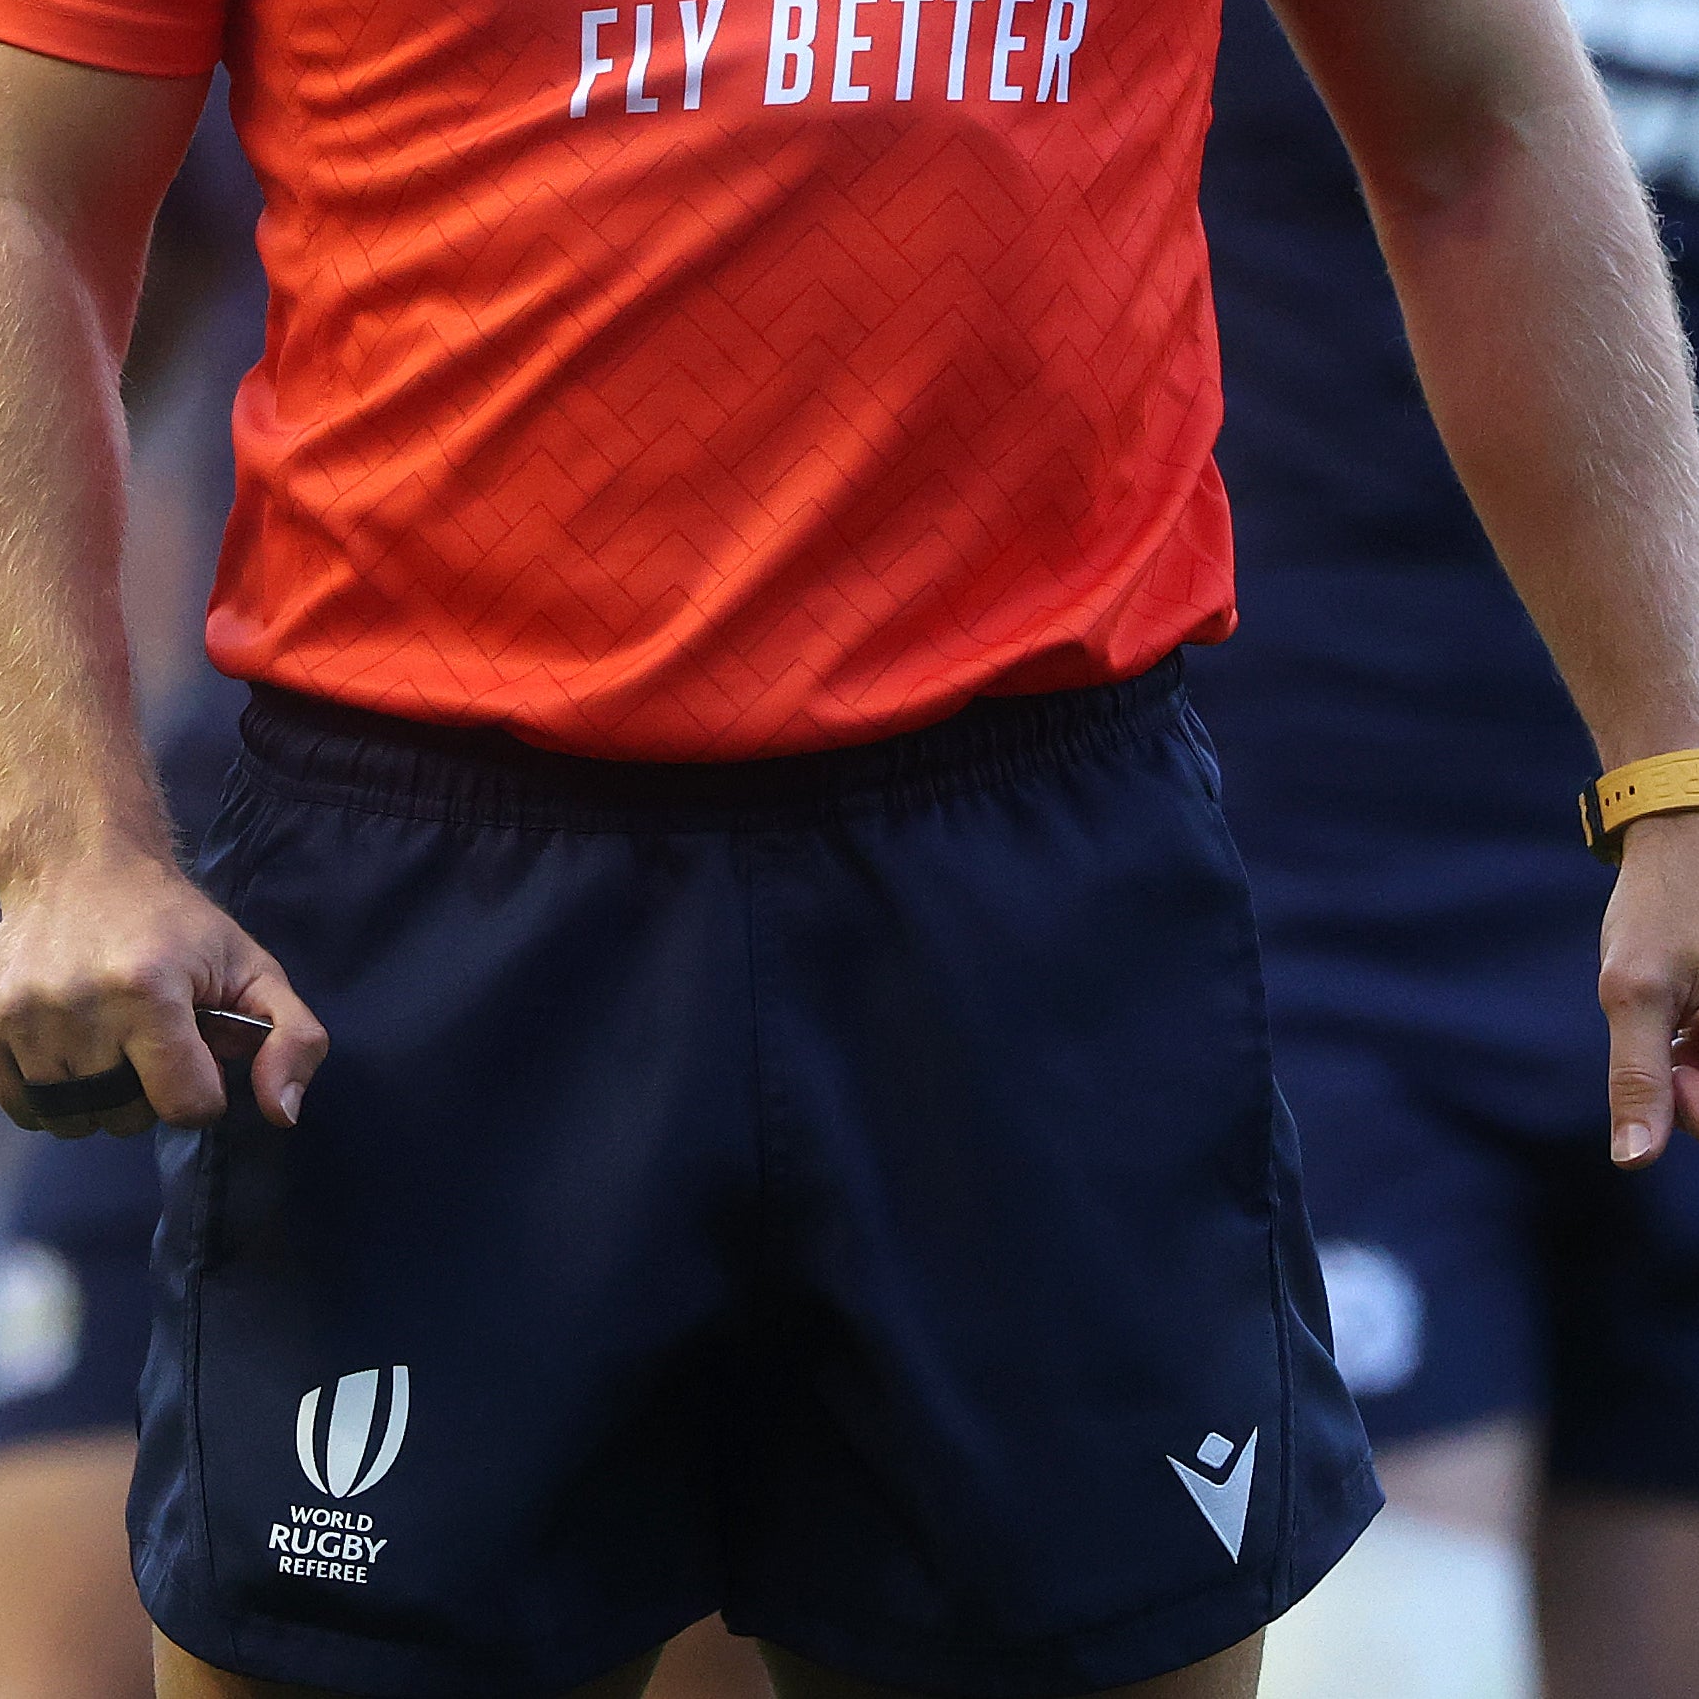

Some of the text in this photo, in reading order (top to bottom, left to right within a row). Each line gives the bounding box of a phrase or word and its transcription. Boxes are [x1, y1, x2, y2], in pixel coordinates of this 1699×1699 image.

[290, 1505, 373, 1532] WORLD
[268, 1522, 388, 1564] RUGBY
[278, 1555, 368, 1584] REFEREE
